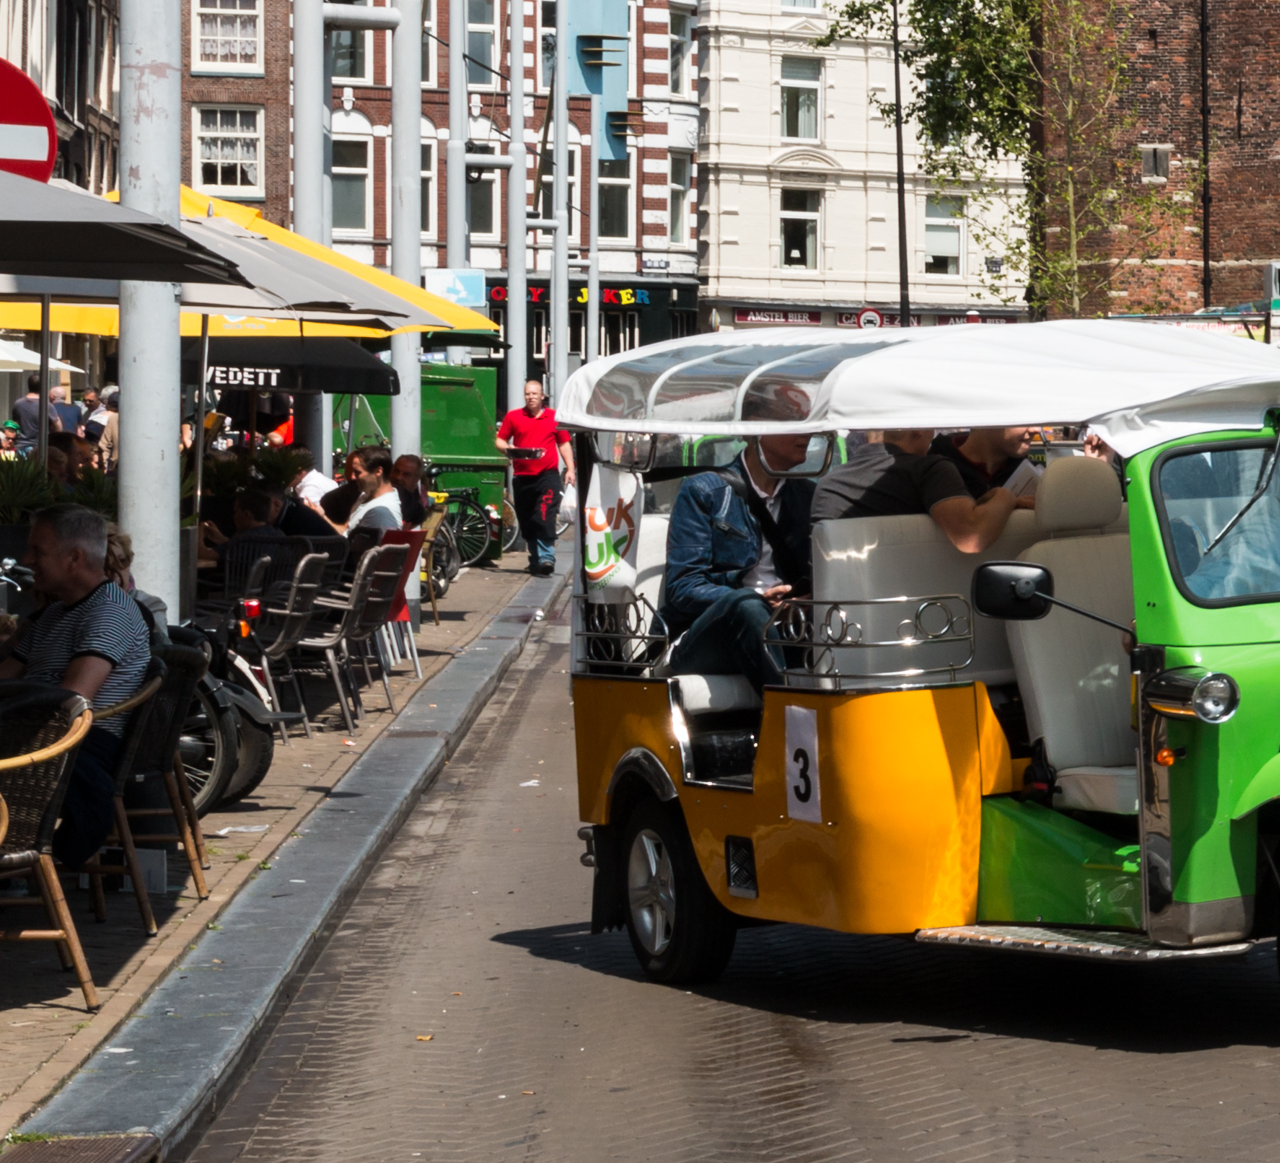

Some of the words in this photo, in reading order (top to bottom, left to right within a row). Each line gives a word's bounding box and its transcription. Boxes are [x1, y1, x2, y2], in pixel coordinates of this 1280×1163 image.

[576, 287, 650, 305] JKER
[747, 311, 786, 322] AMSTEL
[787, 313, 810, 323] BIER
[792, 747, 813, 804] 3
